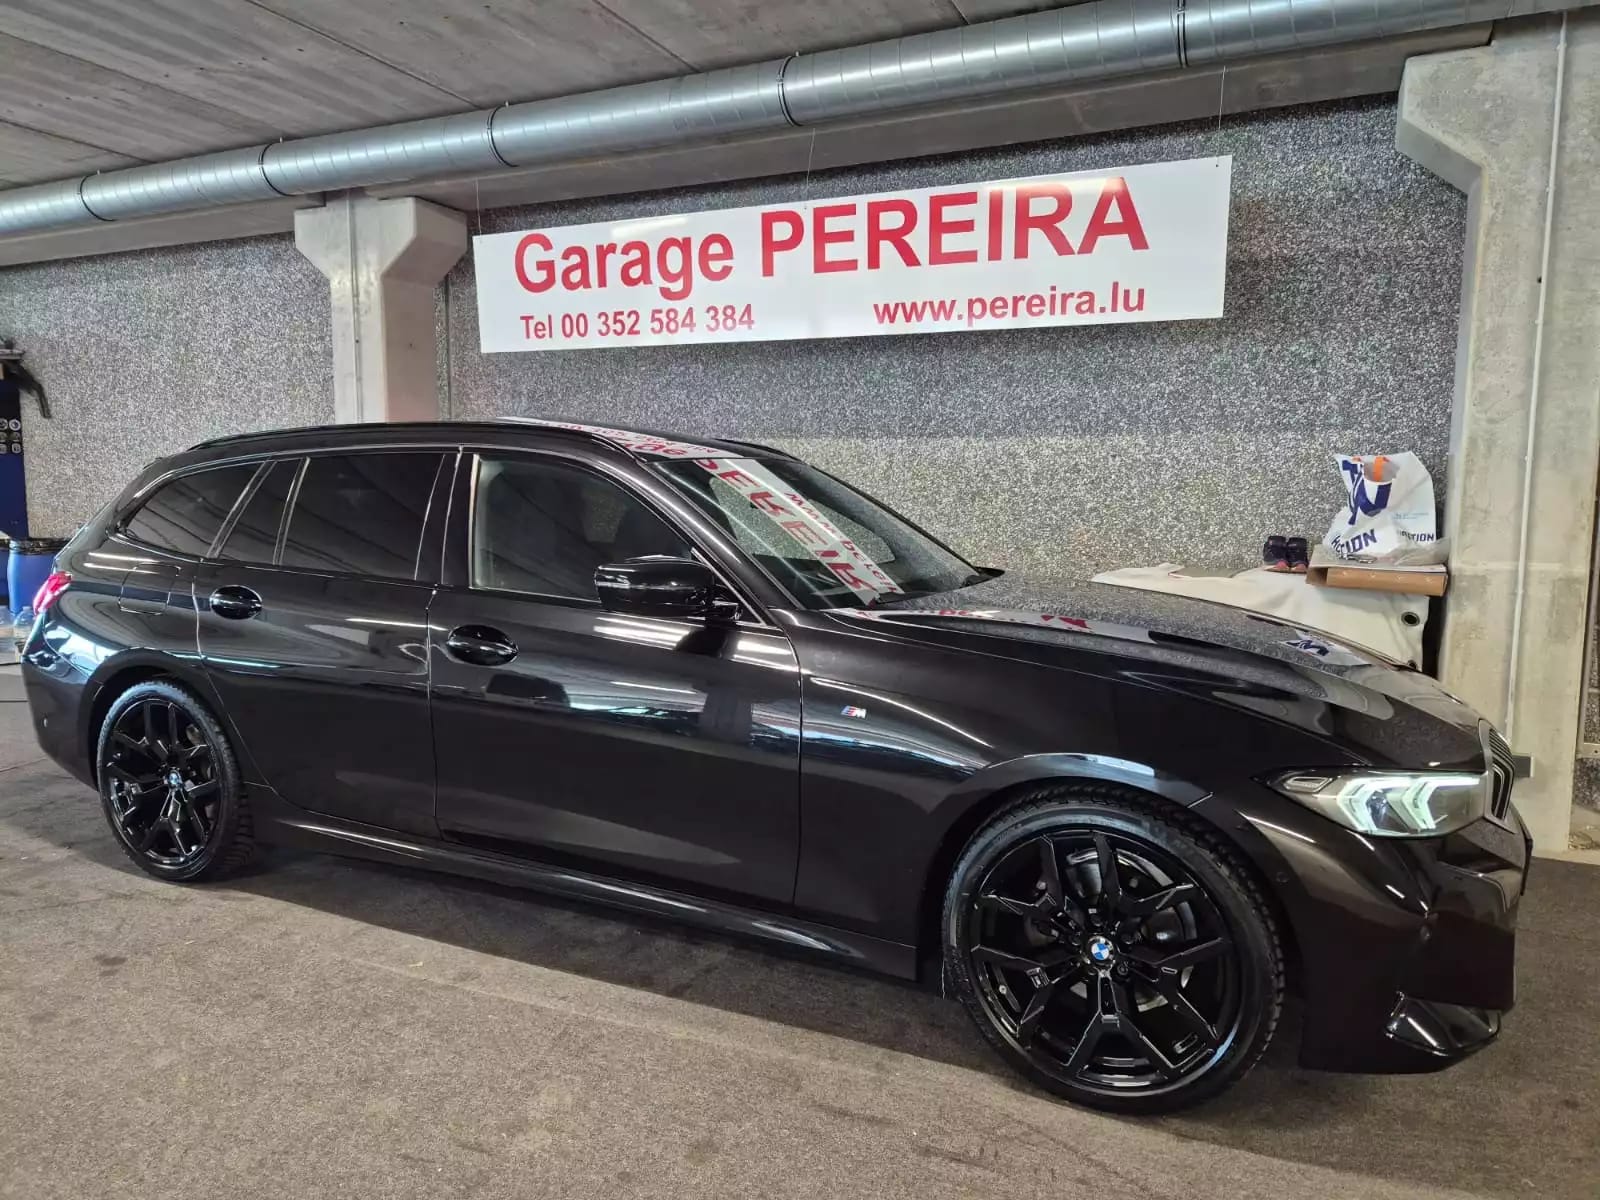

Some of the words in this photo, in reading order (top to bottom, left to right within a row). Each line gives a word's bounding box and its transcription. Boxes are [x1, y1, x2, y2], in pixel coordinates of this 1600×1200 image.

[514, 233, 734, 301] Garage
[760, 176, 1150, 278] PEREIRA
[520, 314, 553, 339] Tel
[561, 312, 589, 339] 00
[598, 308, 641, 337] 352
[650, 306, 696, 335] 584
[706, 303, 755, 332] 384
[873, 281, 1145, 326] www.pereira.lu
